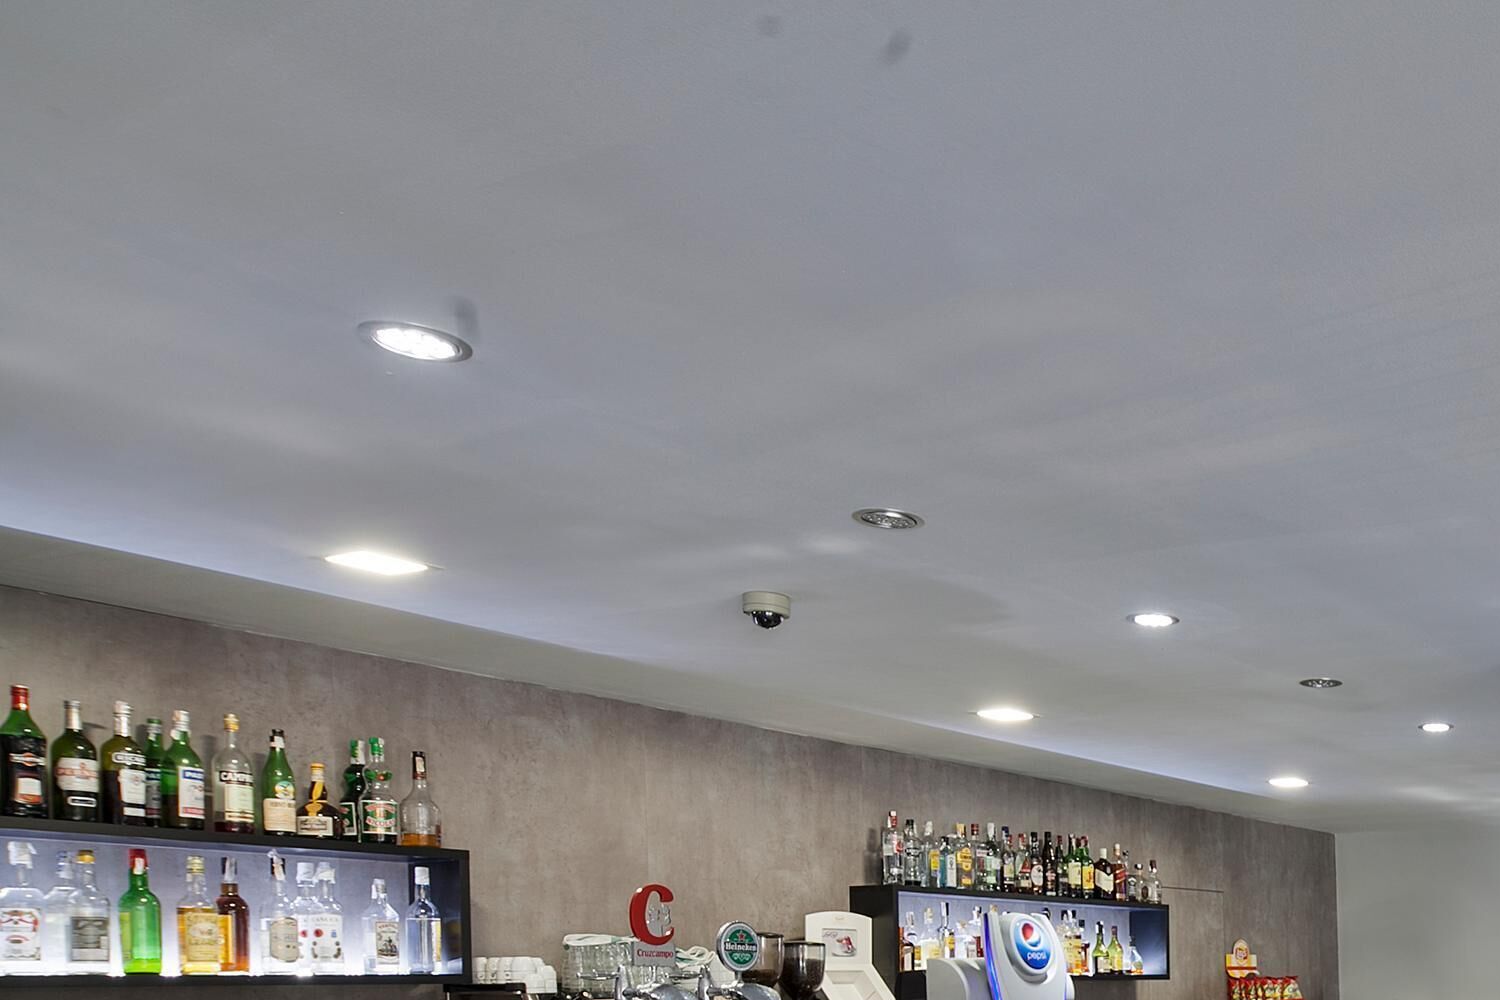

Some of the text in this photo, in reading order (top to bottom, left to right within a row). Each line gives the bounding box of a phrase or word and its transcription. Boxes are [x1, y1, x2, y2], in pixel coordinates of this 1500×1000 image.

[629, 884, 675, 946] C
[725, 942, 757, 952] Heineken
[637, 948, 674, 959] Cruzcampo
[1026, 950, 1047, 961] pepsi
